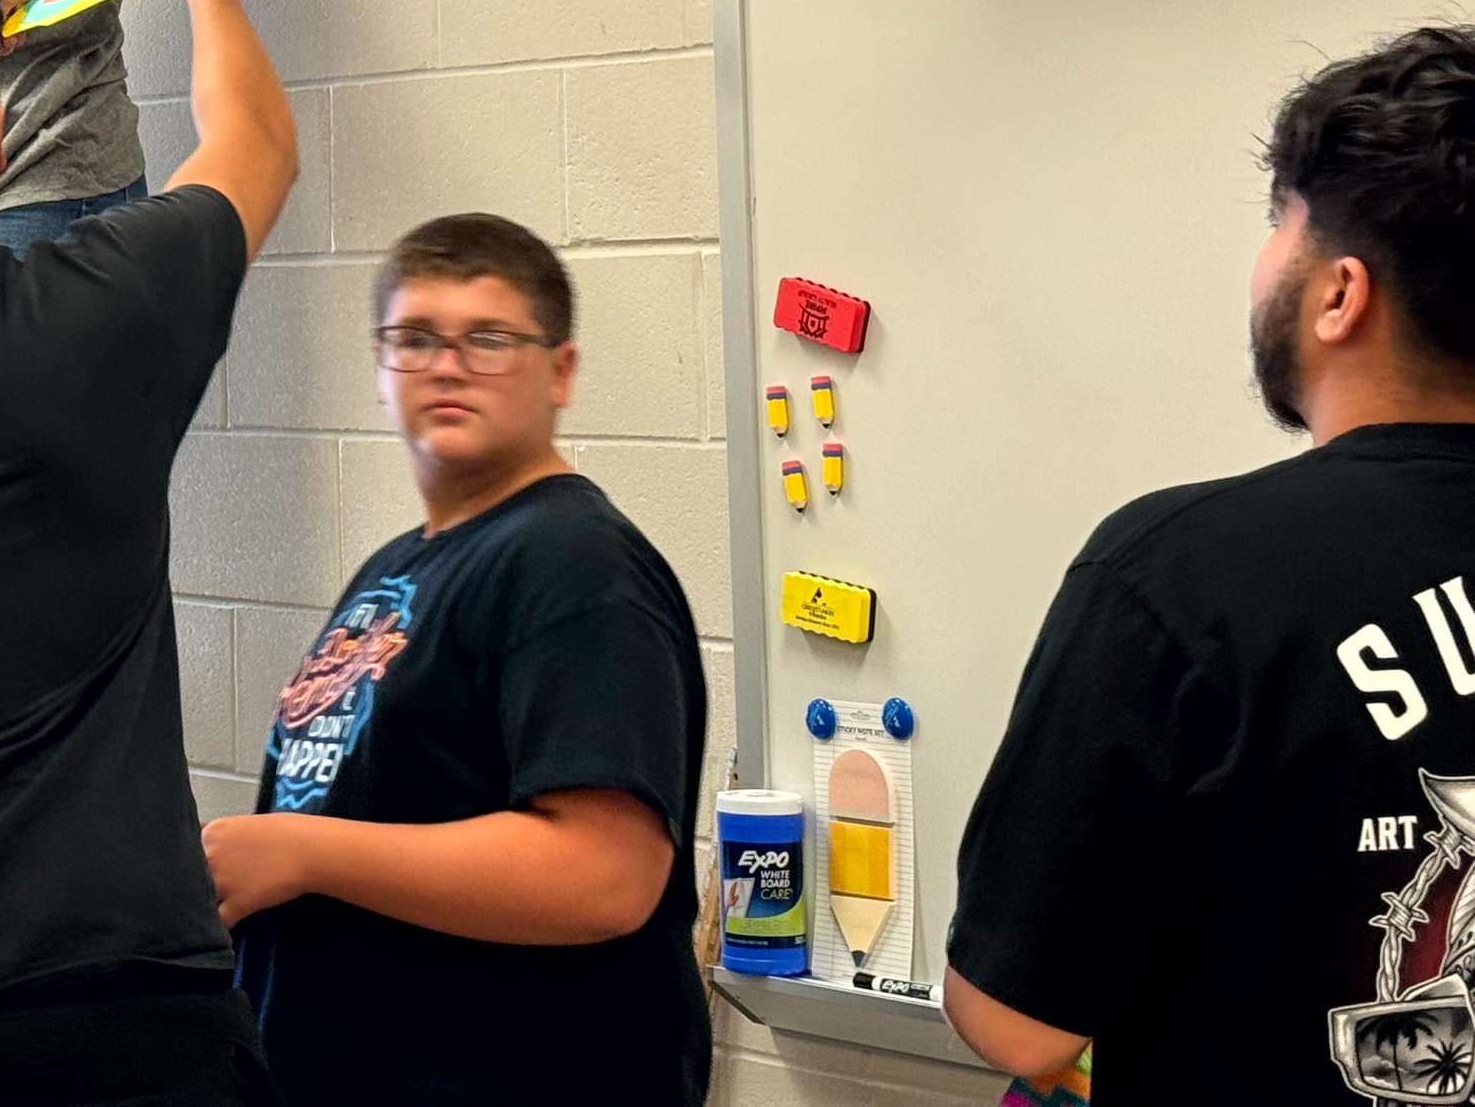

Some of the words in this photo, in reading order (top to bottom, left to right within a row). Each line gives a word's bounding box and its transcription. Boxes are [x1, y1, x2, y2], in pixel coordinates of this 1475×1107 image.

[1357, 816, 1418, 852] ART
[738, 850, 790, 874] EXPO
[760, 870, 790, 879] WHITE
[760, 879, 790, 889] BOARD
[882, 980, 910, 993] EXPO
